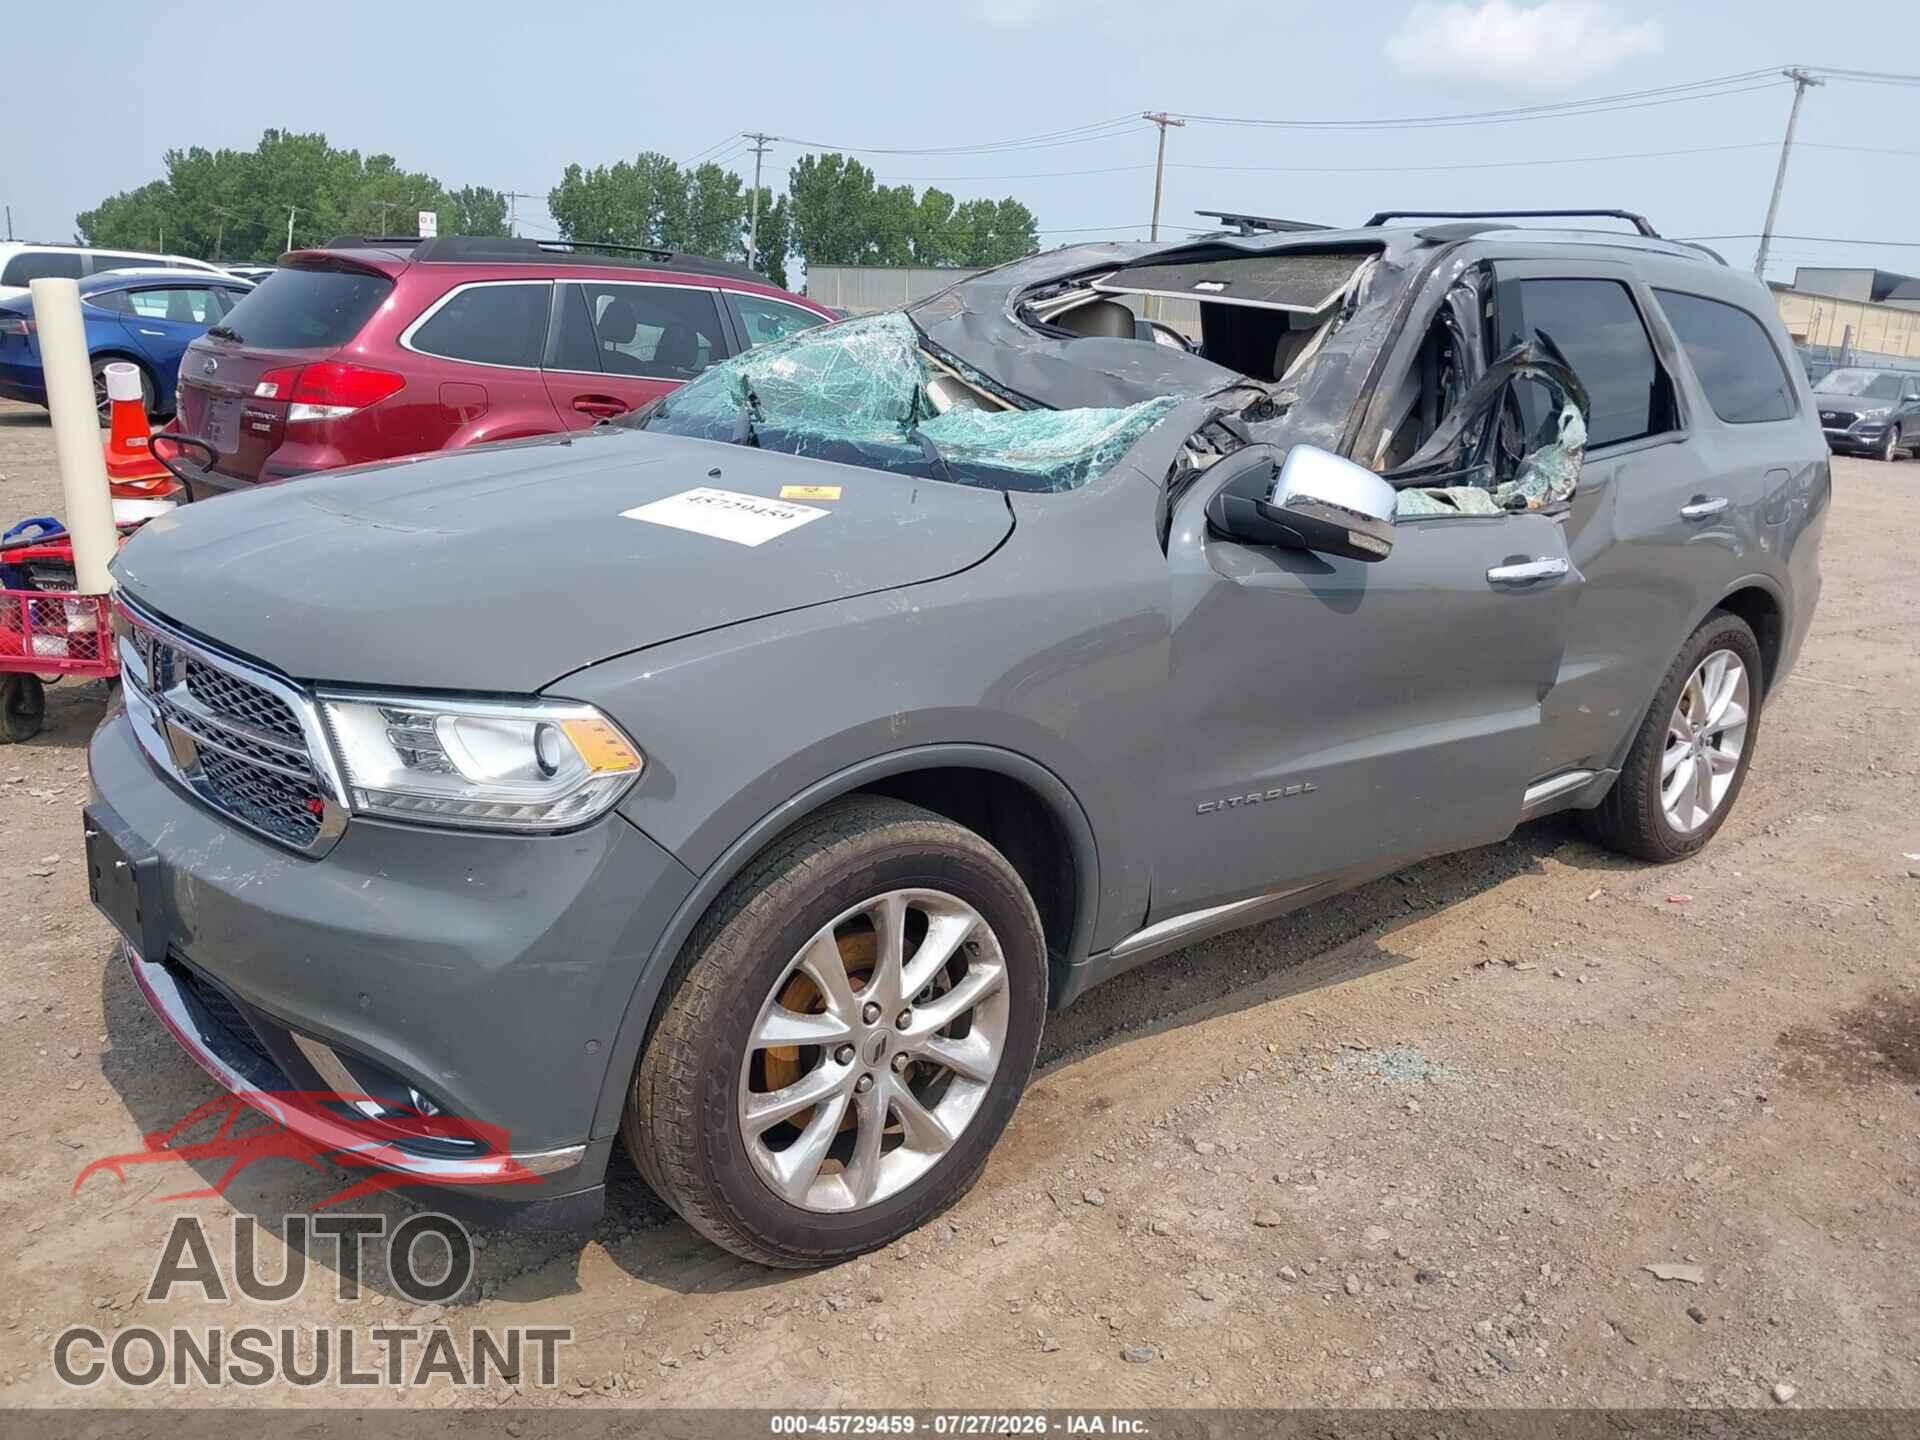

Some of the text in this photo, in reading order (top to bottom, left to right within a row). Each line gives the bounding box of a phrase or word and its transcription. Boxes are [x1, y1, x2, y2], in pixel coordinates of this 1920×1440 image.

[686, 496, 795, 519] 45729459
[253, 781, 306, 806] DODGE
[1196, 782, 1318, 815] CITADEL
